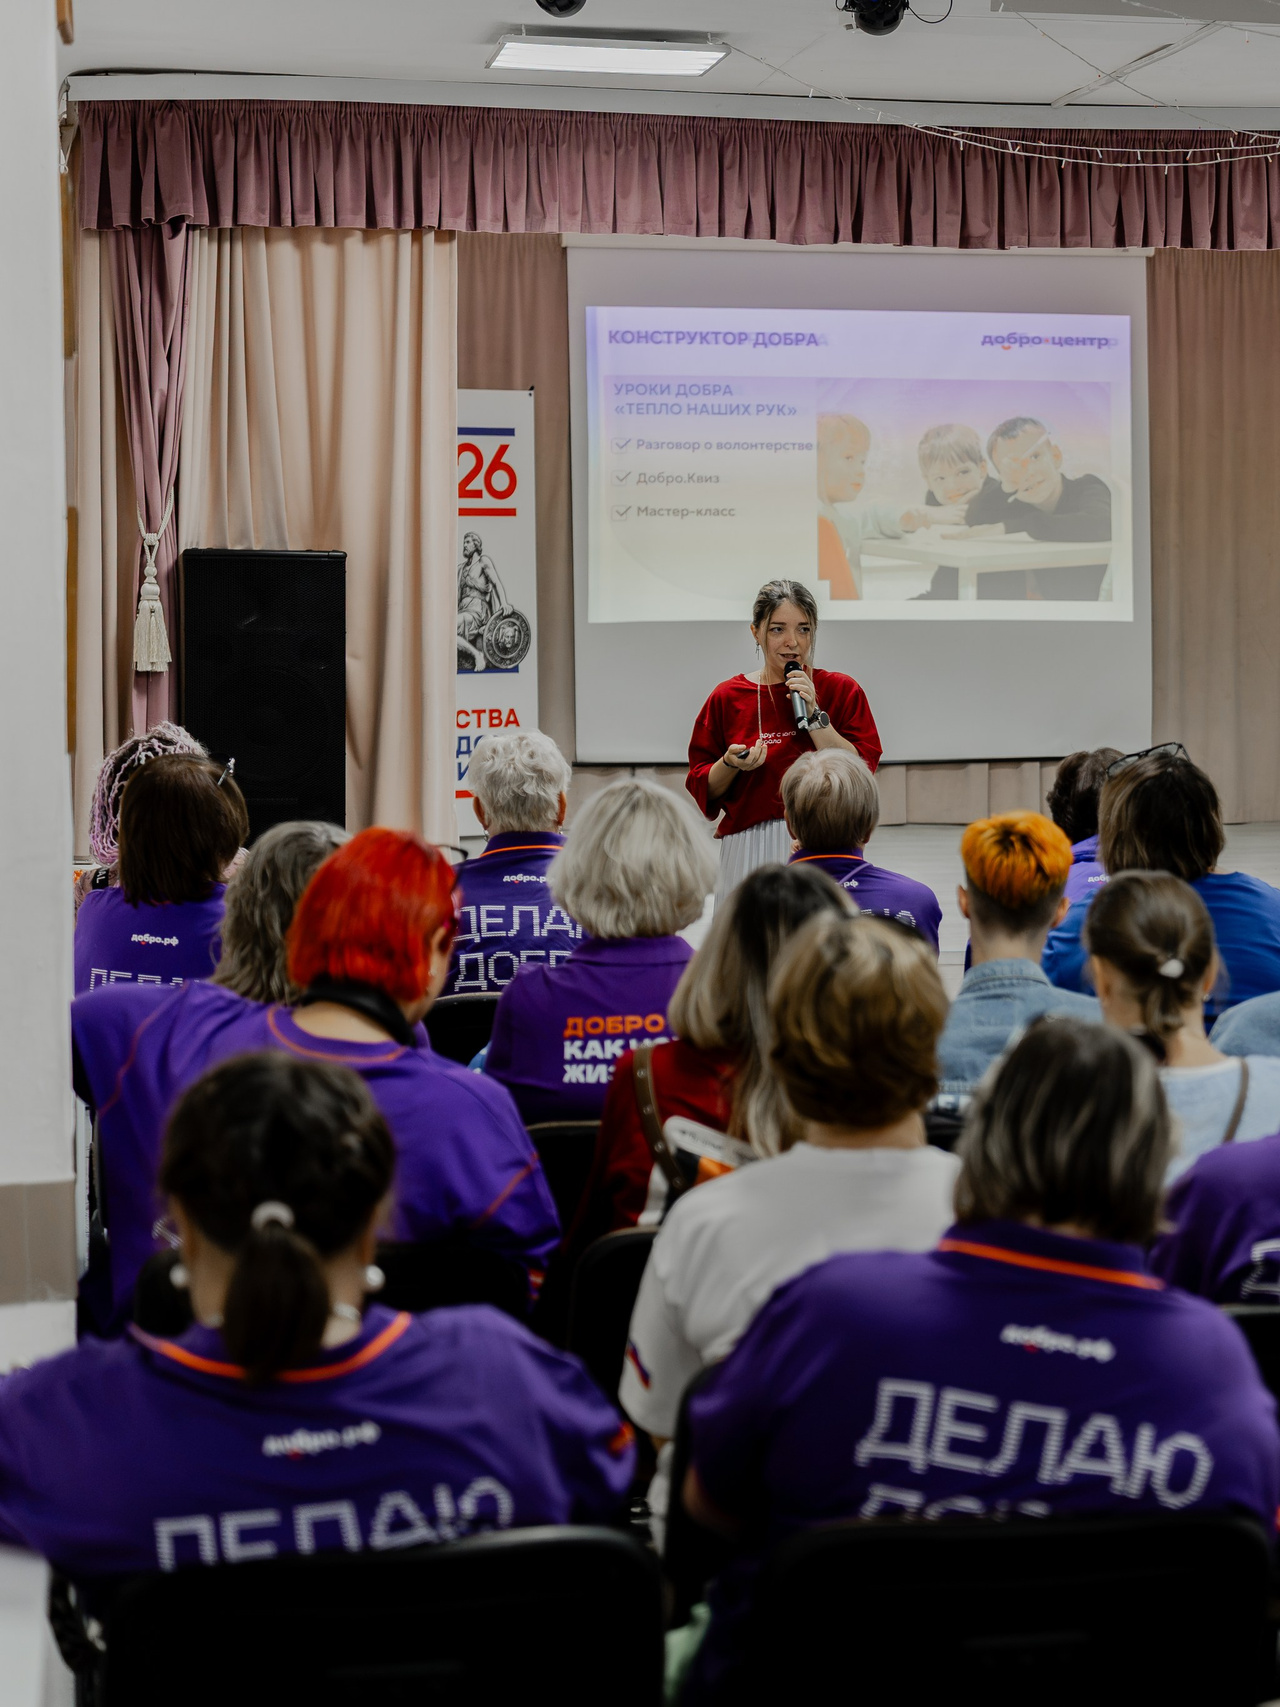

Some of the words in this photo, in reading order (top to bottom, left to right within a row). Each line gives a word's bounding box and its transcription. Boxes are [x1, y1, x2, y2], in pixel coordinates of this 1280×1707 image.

[608, 330, 749, 346] КОНСТРУКТОР
[753, 332, 820, 348] ДОБРА
[613, 383, 671, 396] УРОКИ
[675, 384, 734, 397] ДОБРА
[614, 402, 682, 416] «ТЕПЛО
[686, 403, 752, 416] НАШИХ
[755, 403, 798, 416] РУК»
[636, 439, 701, 453] Разговор
[704, 441, 713, 450] о
[716, 441, 814, 453] волонтерстве
[636, 472, 720, 487] Добро.Квиз
[636, 506, 736, 520] Мастер-класс
[456, 708, 521, 729] СТВА
[130, 933, 180, 947] добро.рф
[562, 1013, 666, 1039] ДОБРО
[563, 1039, 626, 1061] КАК
[853, 1376, 1214, 1510] ДЕЛАЮ
